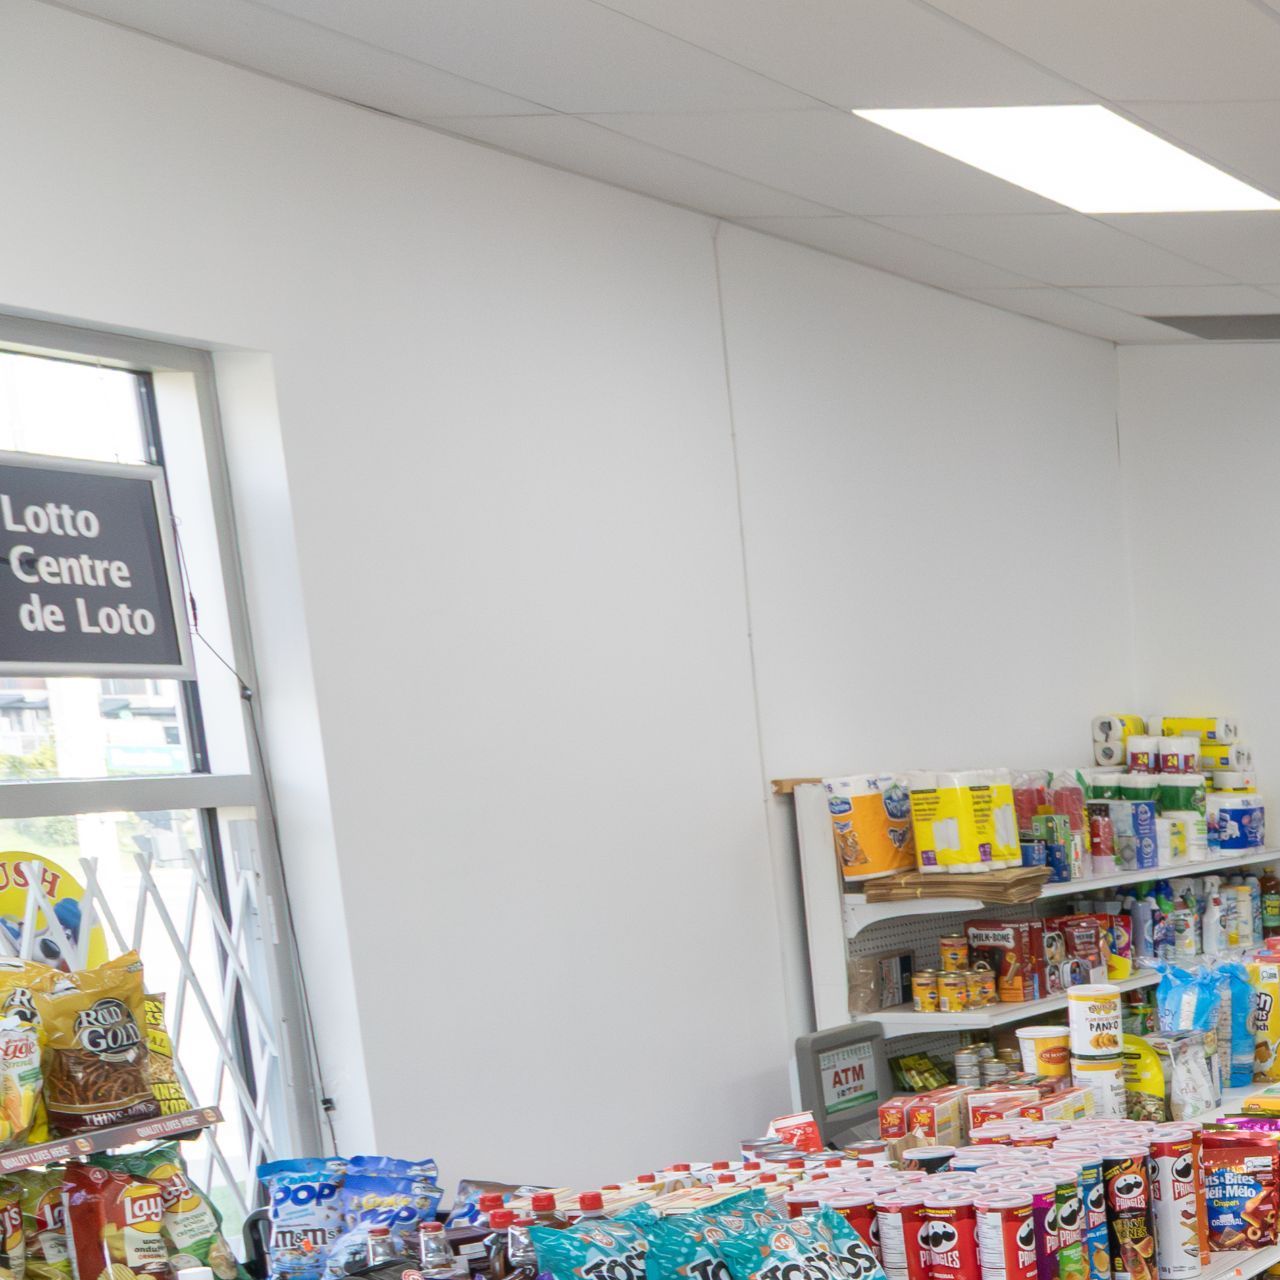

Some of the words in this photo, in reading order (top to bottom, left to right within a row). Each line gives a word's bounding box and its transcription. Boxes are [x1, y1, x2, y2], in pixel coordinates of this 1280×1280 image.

[2, 496, 100, 538] Lotto
[9, 546, 131, 588] Centre
[20, 594, 65, 632] de
[79, 598, 156, 636] Loto
[971, 930, 1012, 945] MILK-BONE
[80, 1023, 140, 1052] GOLD
[1089, 1021, 1119, 1032] PANKO
[832, 1063, 865, 1088] ATM
[137, 1123, 163, 1138] QUALITY
[163, 1119, 181, 1132] LIVES
[1, 1154, 31, 1169] QUALITY
[31, 1150, 50, 1162] LIVES
[272, 1182, 336, 1207] POP
[1115, 1195, 1146, 1211] PRINGLES
